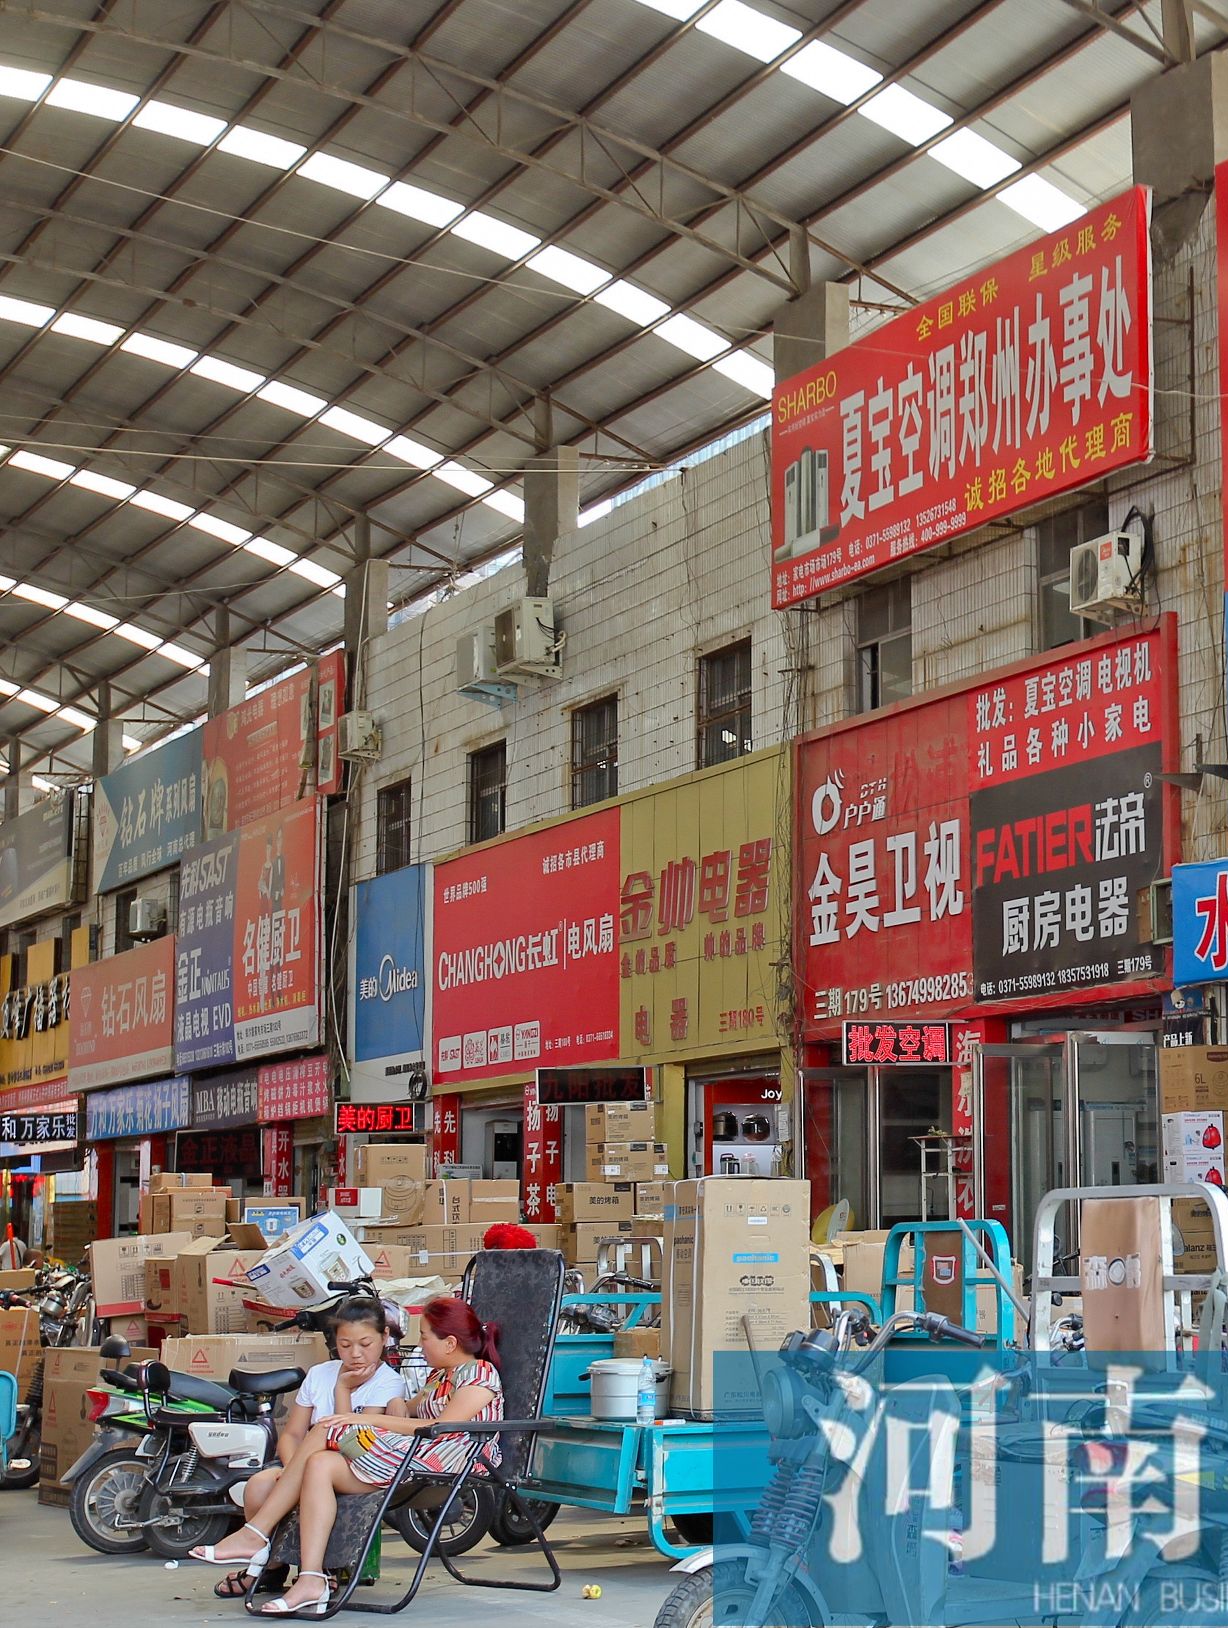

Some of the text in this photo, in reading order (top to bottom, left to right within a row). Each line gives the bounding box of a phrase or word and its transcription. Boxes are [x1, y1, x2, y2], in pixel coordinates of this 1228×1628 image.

[915, 212, 1122, 341] 全国联保 星级服务
[777, 371, 838, 425] SHARBO
[839, 255, 1133, 528] 夏宝空调郑州办事处
[964, 412, 1133, 512] 诚招各地代理商
[1098, 640, 1151, 696] 电视机
[977, 696, 1152, 778] 礼品各种小家电
[843, 796, 888, 829] 户户通
[975, 803, 1096, 887] FATIER
[443, 876, 487, 904] 世界品牌500强
[619, 837, 772, 944] 金帅电器
[809, 818, 964, 947] 金昊卫视
[243, 907, 301, 976] 名健厨卫
[1002, 876, 1129, 957] 厨房电器
[177, 948, 201, 1003] 金正
[360, 954, 417, 1001] 美的 Midea
[438, 913, 614, 991] CHANGHONG 长虹 电风扇
[102, 969, 166, 1038] 钻石风扇
[177, 1007, 209, 1042] 液晶电视
[213, 1002, 232, 1031] EVD
[814, 985, 882, 1021] 三期179号
[848, 1024, 947, 1064] 批发空调
[20, 1115, 66, 1140] 万家乐
[66, 1114, 77, 1138] 批发
[196, 1090, 215, 1114] MBA
[338, 1105, 413, 1132] 美的厨卫
[589, 1196, 619, 1205] 美的烤箱
